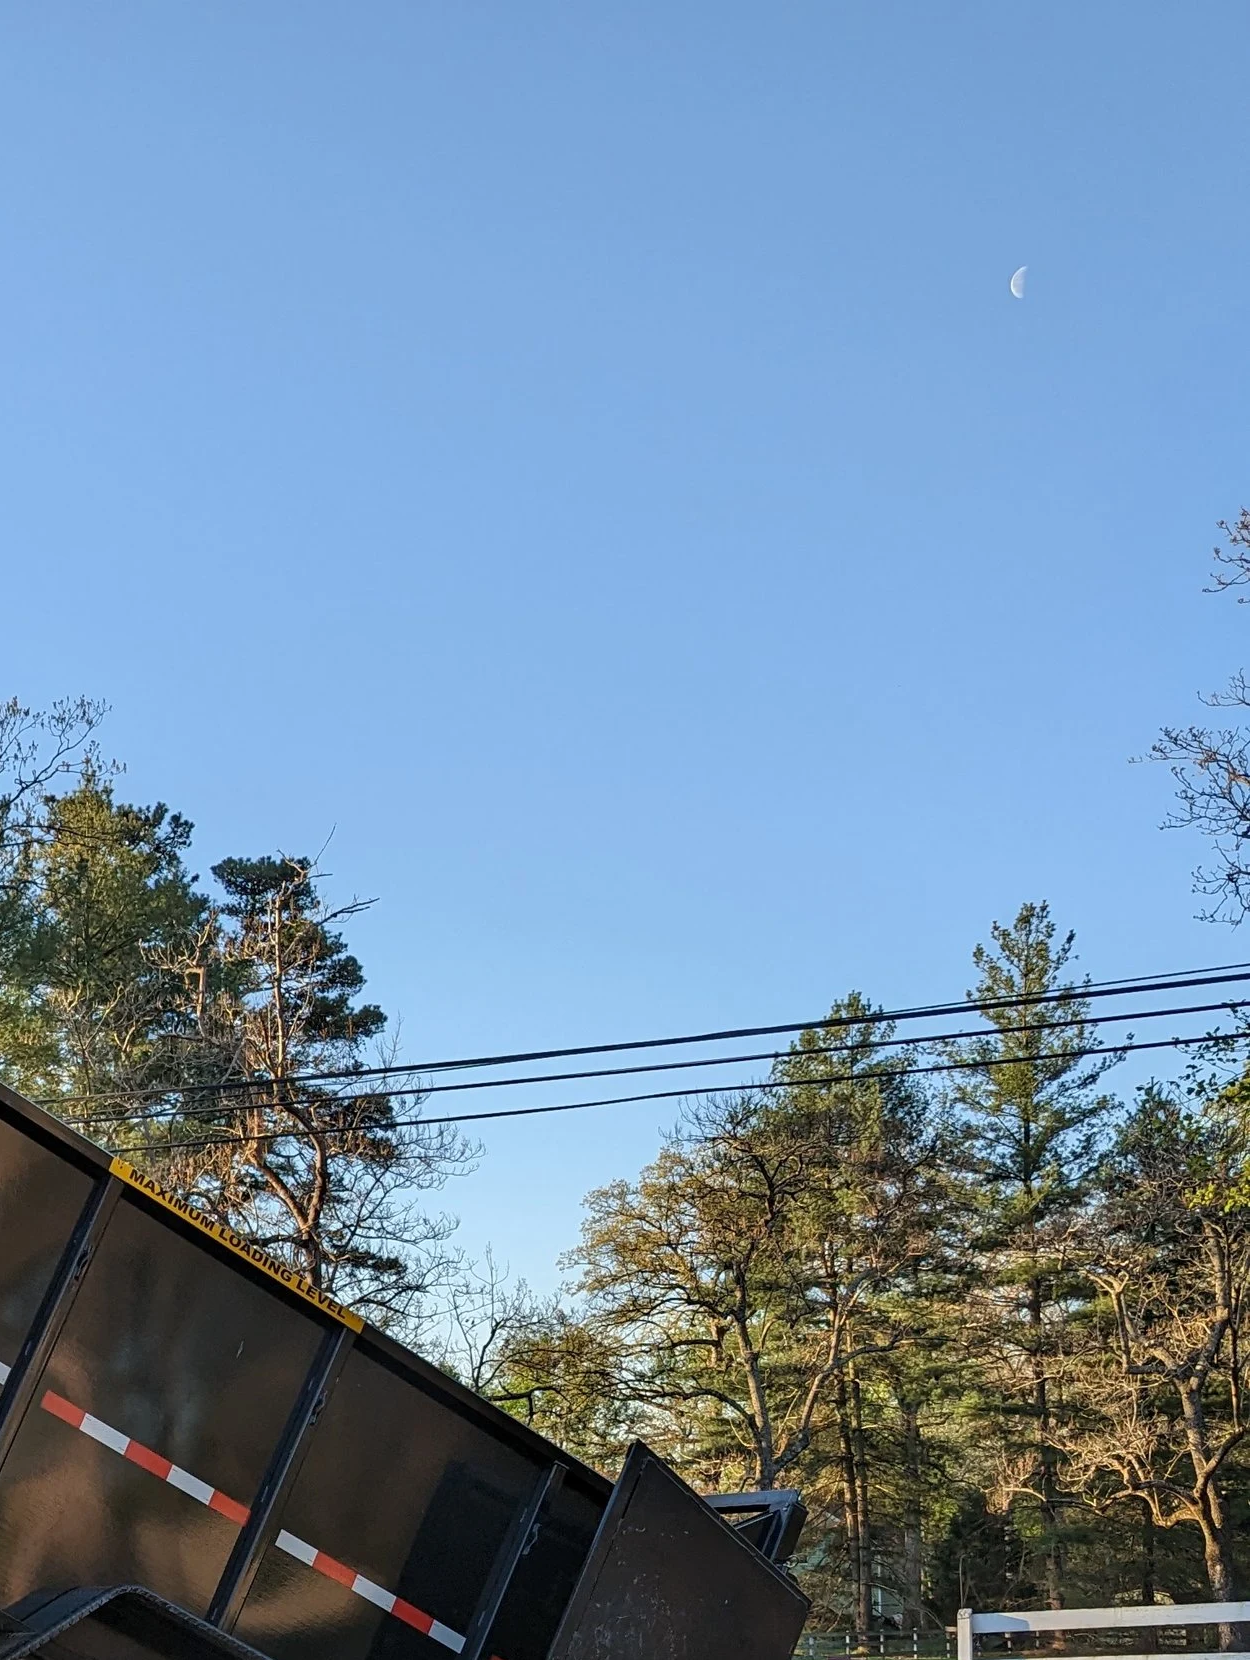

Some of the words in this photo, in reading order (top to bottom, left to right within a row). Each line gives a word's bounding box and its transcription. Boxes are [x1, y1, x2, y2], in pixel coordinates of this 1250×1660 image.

[128, 1168, 216, 1233] MAXIMUM
[218, 1227, 293, 1283] LOADING
[296, 1276, 347, 1320] LEVEL
